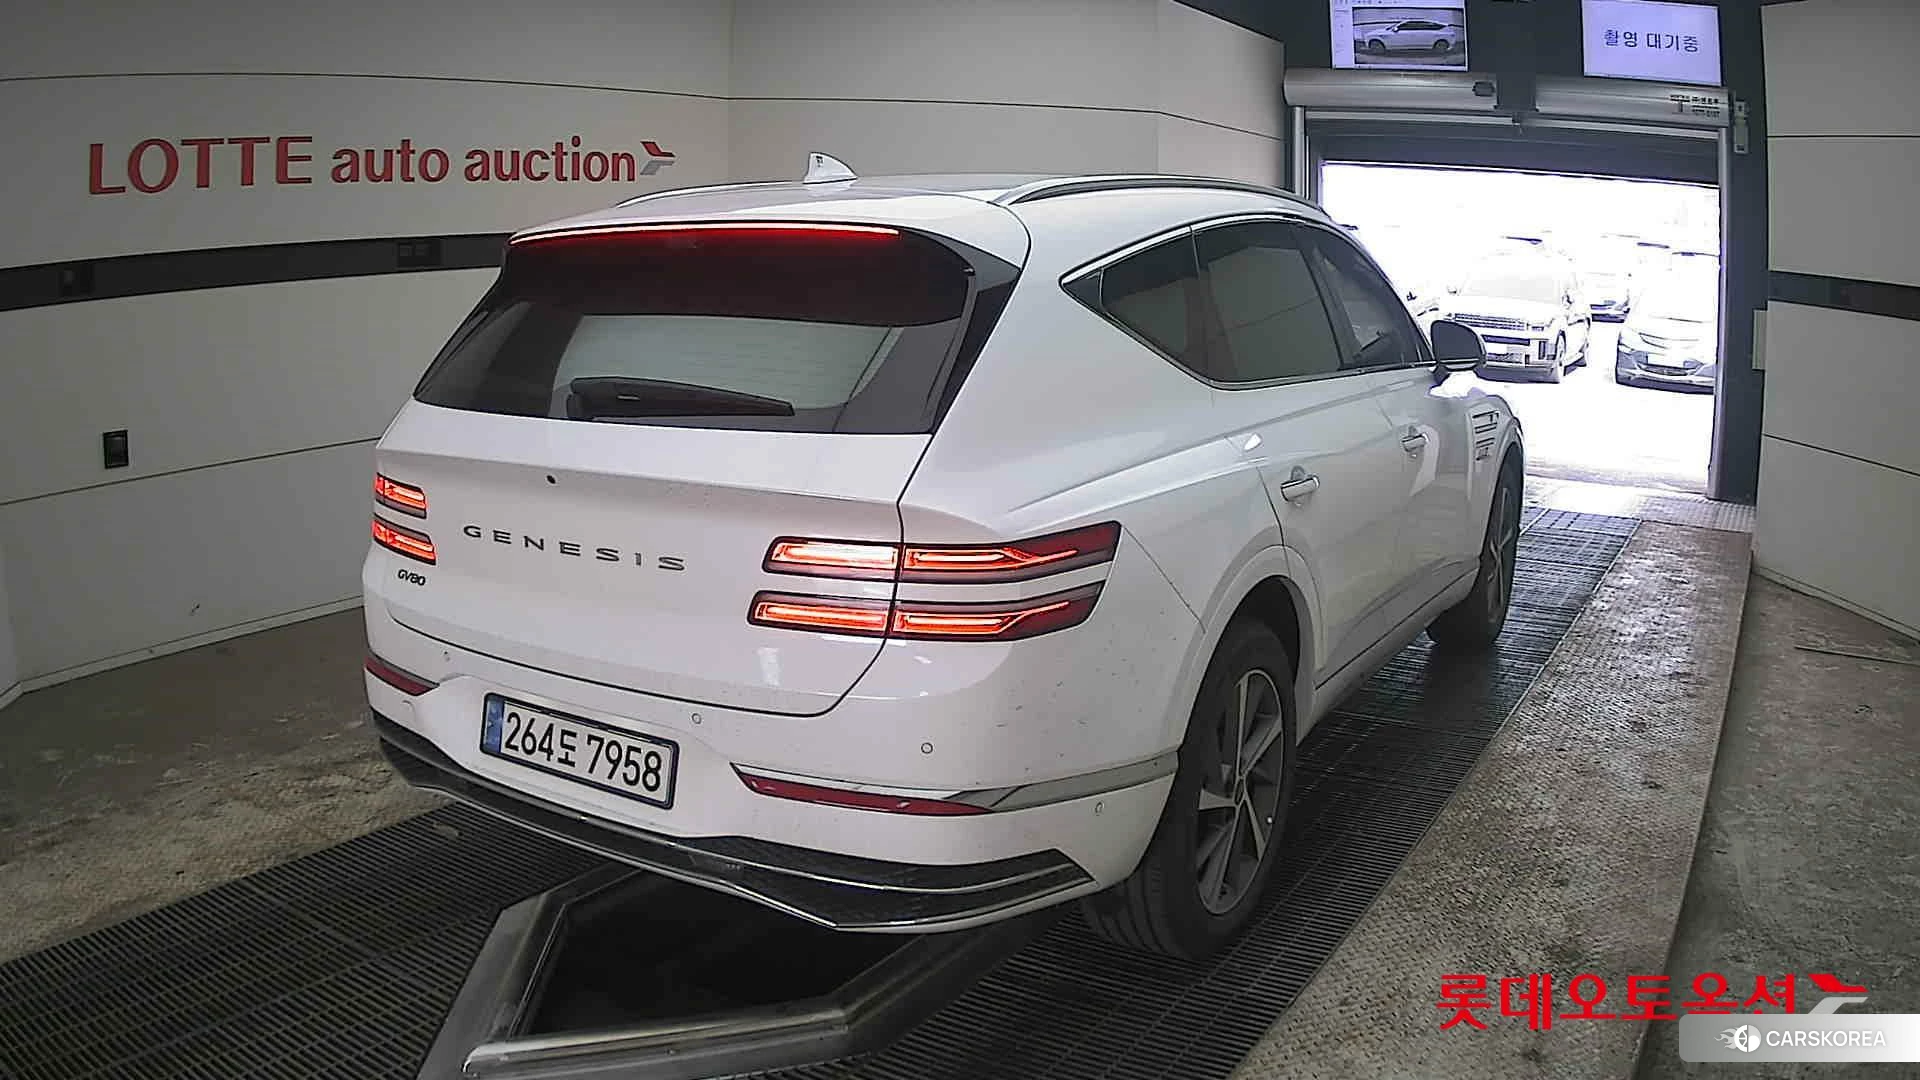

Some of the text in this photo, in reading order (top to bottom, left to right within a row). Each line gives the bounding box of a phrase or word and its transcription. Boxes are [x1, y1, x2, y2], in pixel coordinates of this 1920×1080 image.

[1646, 33, 1698, 53] 대기중
[88, 135, 637, 194] LOTTE auto auction
[463, 524, 686, 572] GENESIS
[397, 568, 426, 586] GV80
[586, 733, 663, 793] 7958
